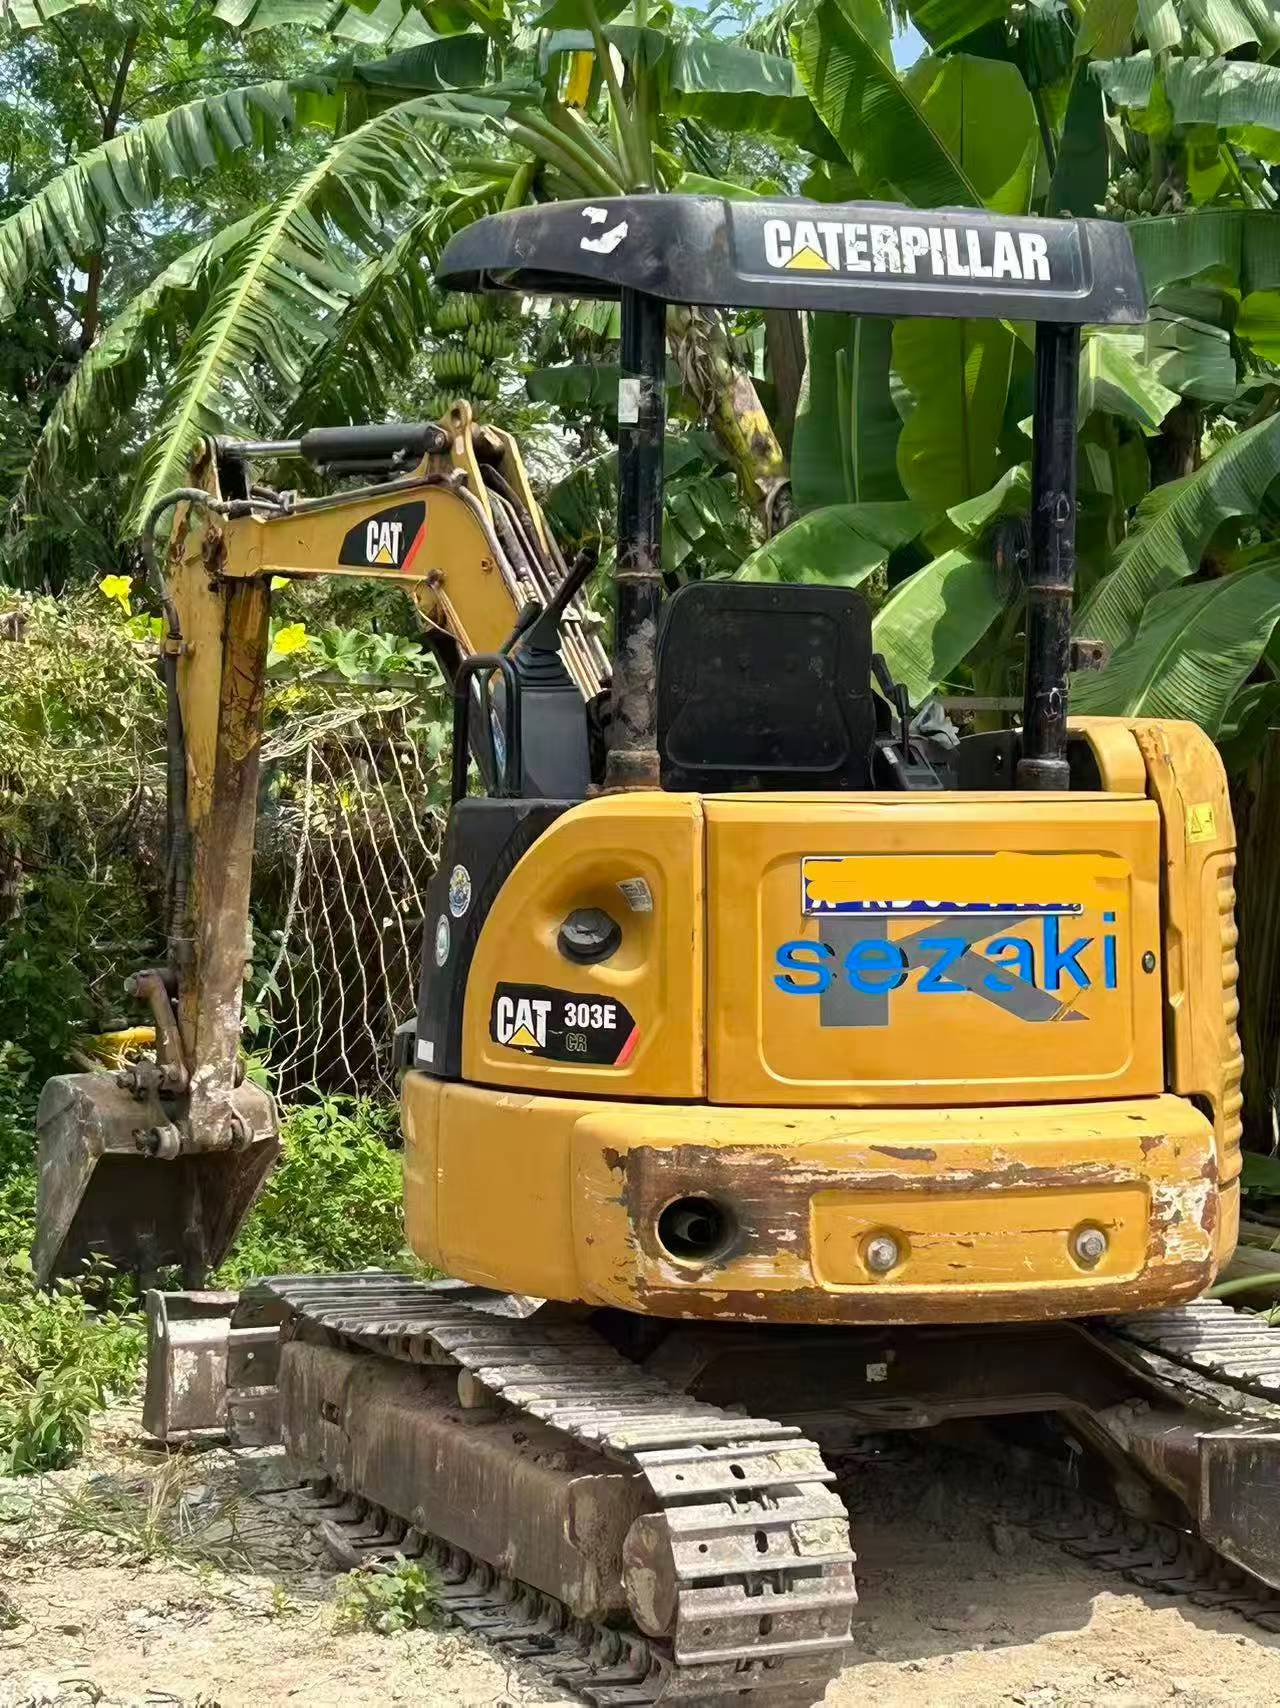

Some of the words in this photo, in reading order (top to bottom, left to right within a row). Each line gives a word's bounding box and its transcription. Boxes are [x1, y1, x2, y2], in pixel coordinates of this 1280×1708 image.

[763, 218, 1051, 281] CATERPILLAR
[365, 520, 402, 564] CAT
[496, 996, 552, 1048] CAT
[564, 1002, 617, 1029] 303E
[565, 1032, 588, 1052] CR
